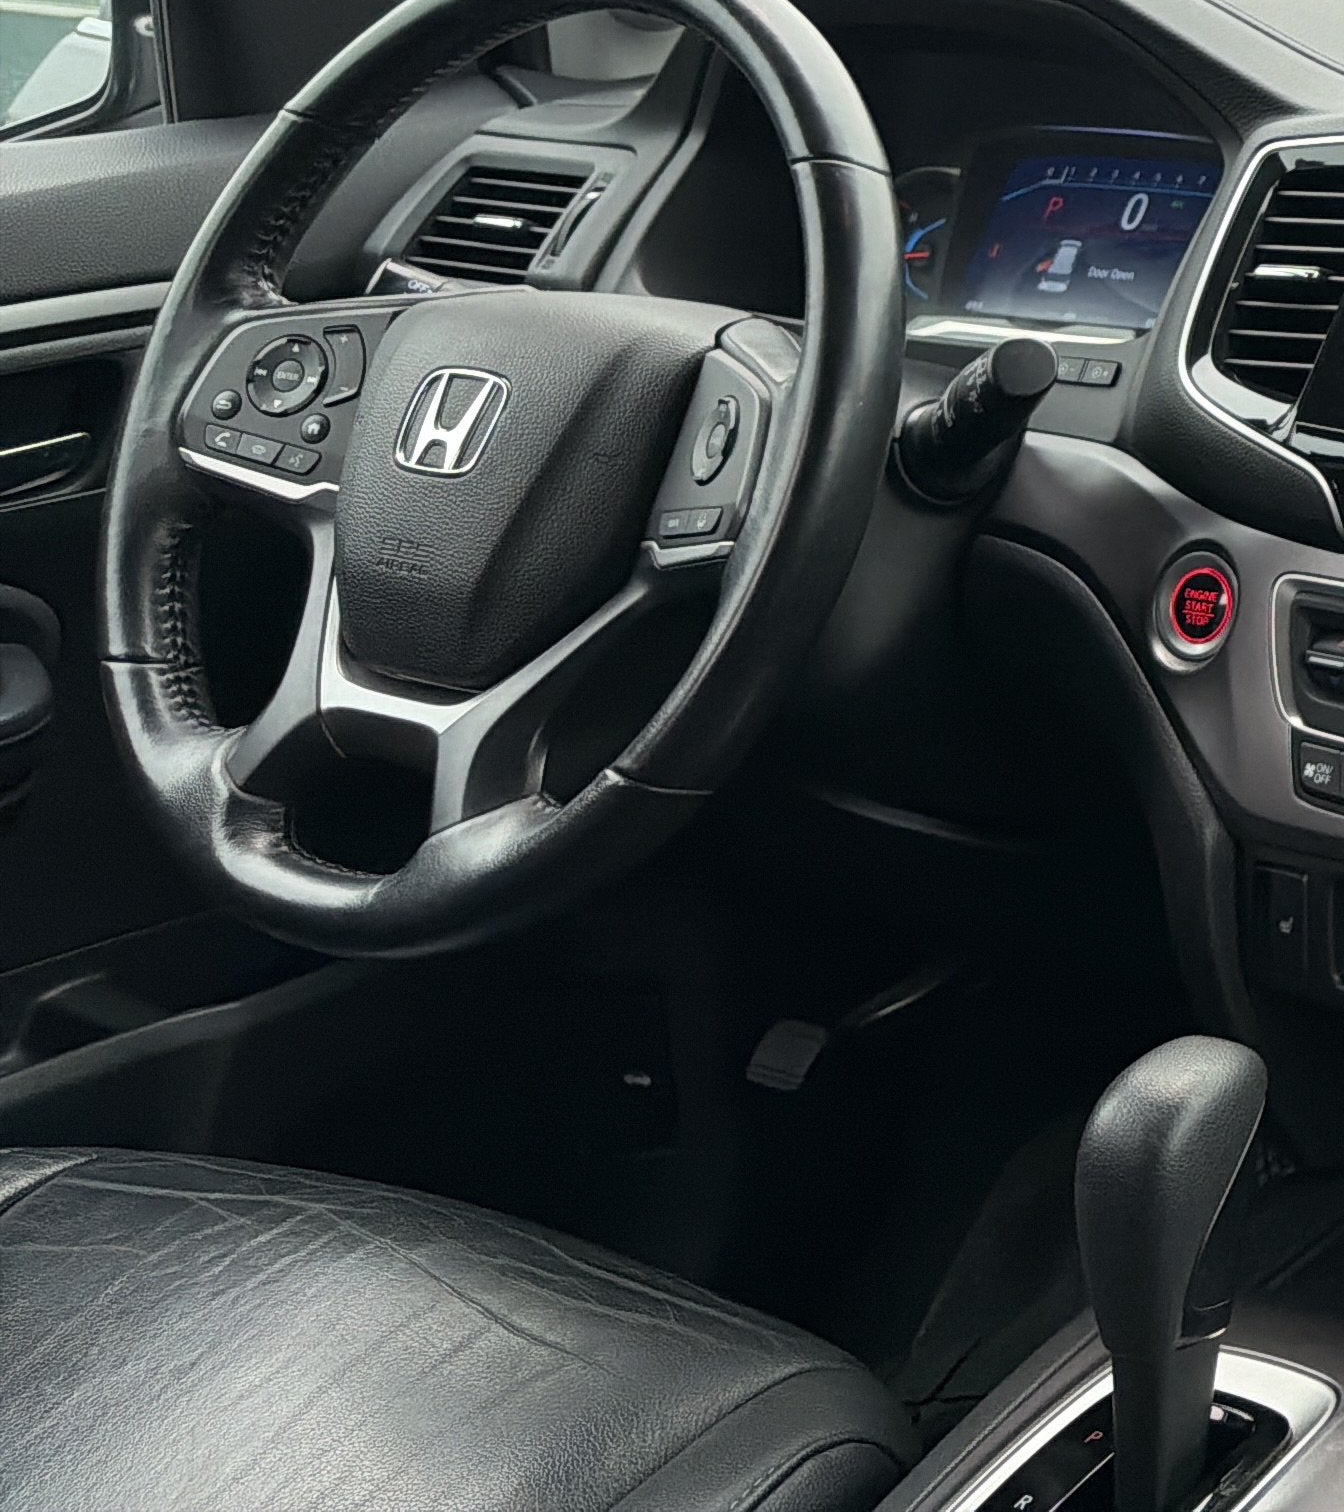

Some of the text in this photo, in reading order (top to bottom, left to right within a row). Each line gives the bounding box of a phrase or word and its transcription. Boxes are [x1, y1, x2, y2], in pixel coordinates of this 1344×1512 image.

[1046, 192, 1149, 231] P 0
[1088, 266, 1134, 281] Door Open
[1184, 588, 1219, 602] ENGINE
[1185, 600, 1214, 613] START
[1185, 615, 1210, 626] STOP
[1315, 763, 1334, 775] ON/
[1313, 774, 1331, 785] OFF
[1083, 1430, 1104, 1444] P
[1013, 1494, 1034, 1510] R
